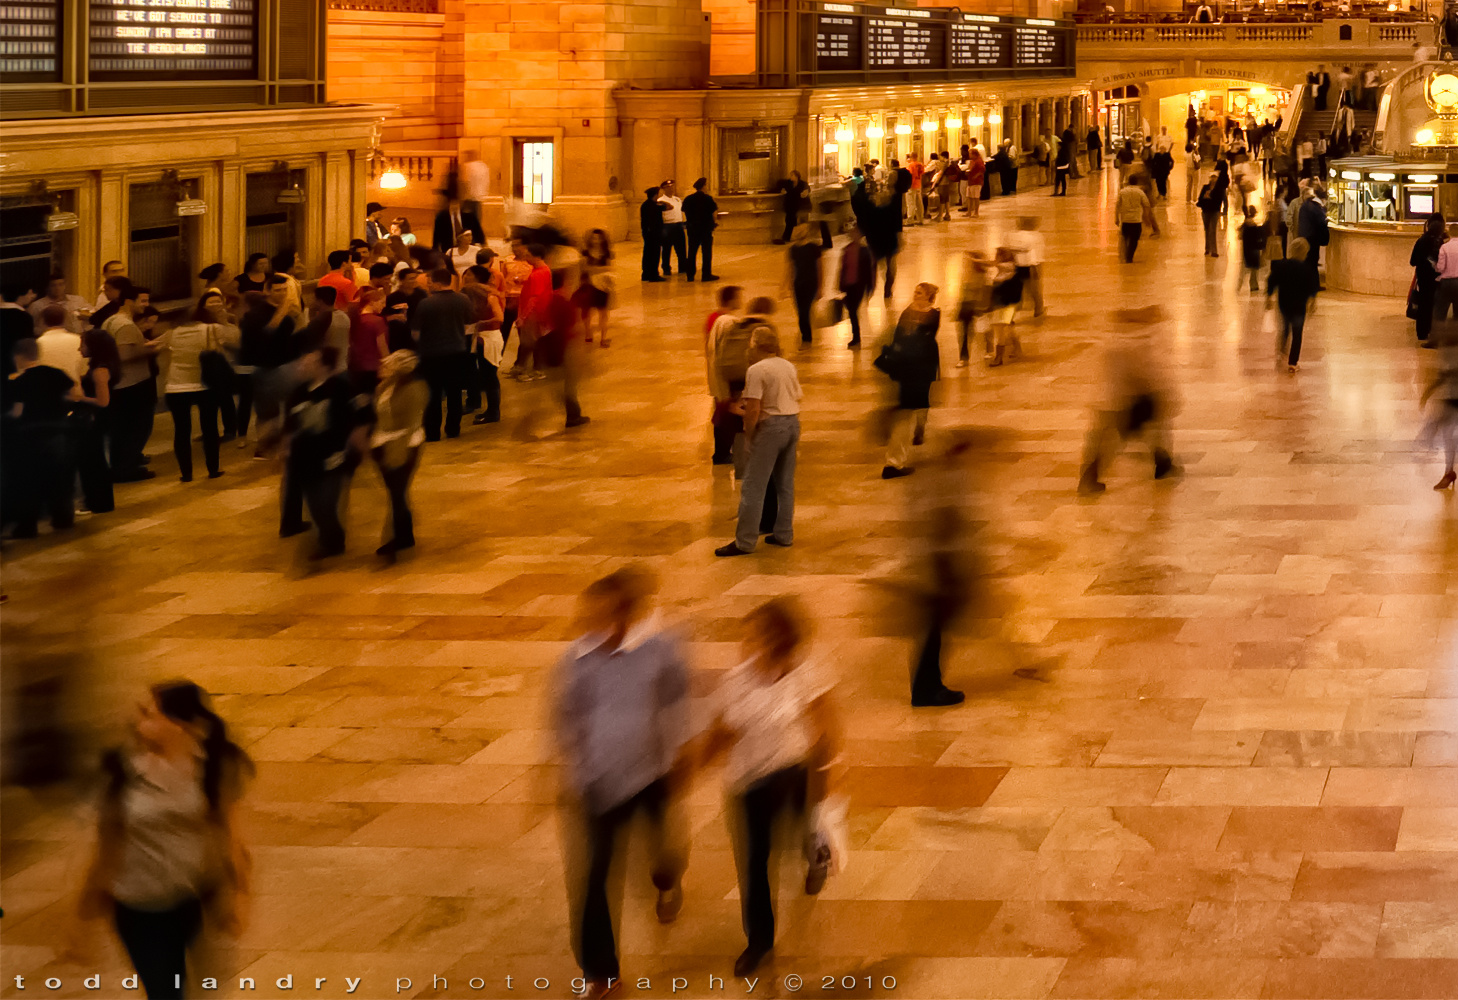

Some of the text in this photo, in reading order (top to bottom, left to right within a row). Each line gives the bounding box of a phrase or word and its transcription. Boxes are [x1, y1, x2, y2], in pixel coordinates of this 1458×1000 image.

[149, 11, 166, 22] GOT
[170, 12, 207, 24] SERVICE
[210, 13, 222, 24] TO
[1103, 67, 1176, 83] SUBWAY SHUTTLE
[1204, 68, 1256, 79] 42ND STREET
